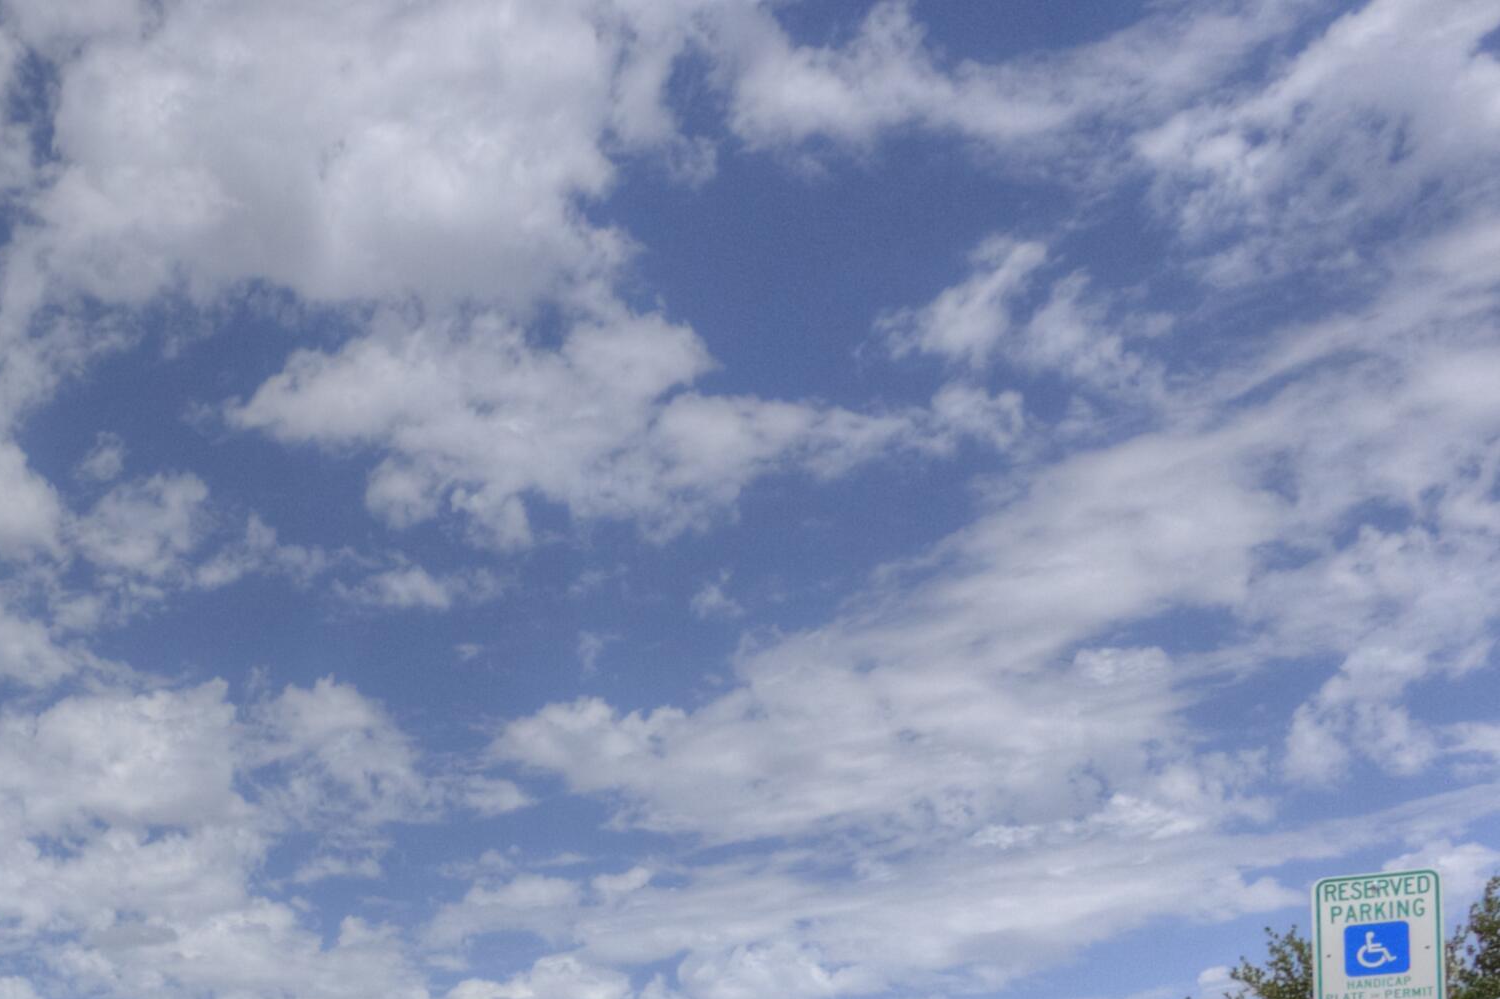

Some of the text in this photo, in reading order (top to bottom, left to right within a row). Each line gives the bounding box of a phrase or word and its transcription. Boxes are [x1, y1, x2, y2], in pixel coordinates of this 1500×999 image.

[1324, 875, 1431, 902] RESERVED
[1330, 898, 1426, 924] PARKING
[1346, 976, 1412, 990] HANDICAP
[1384, 986, 1434, 999] PERMIT
